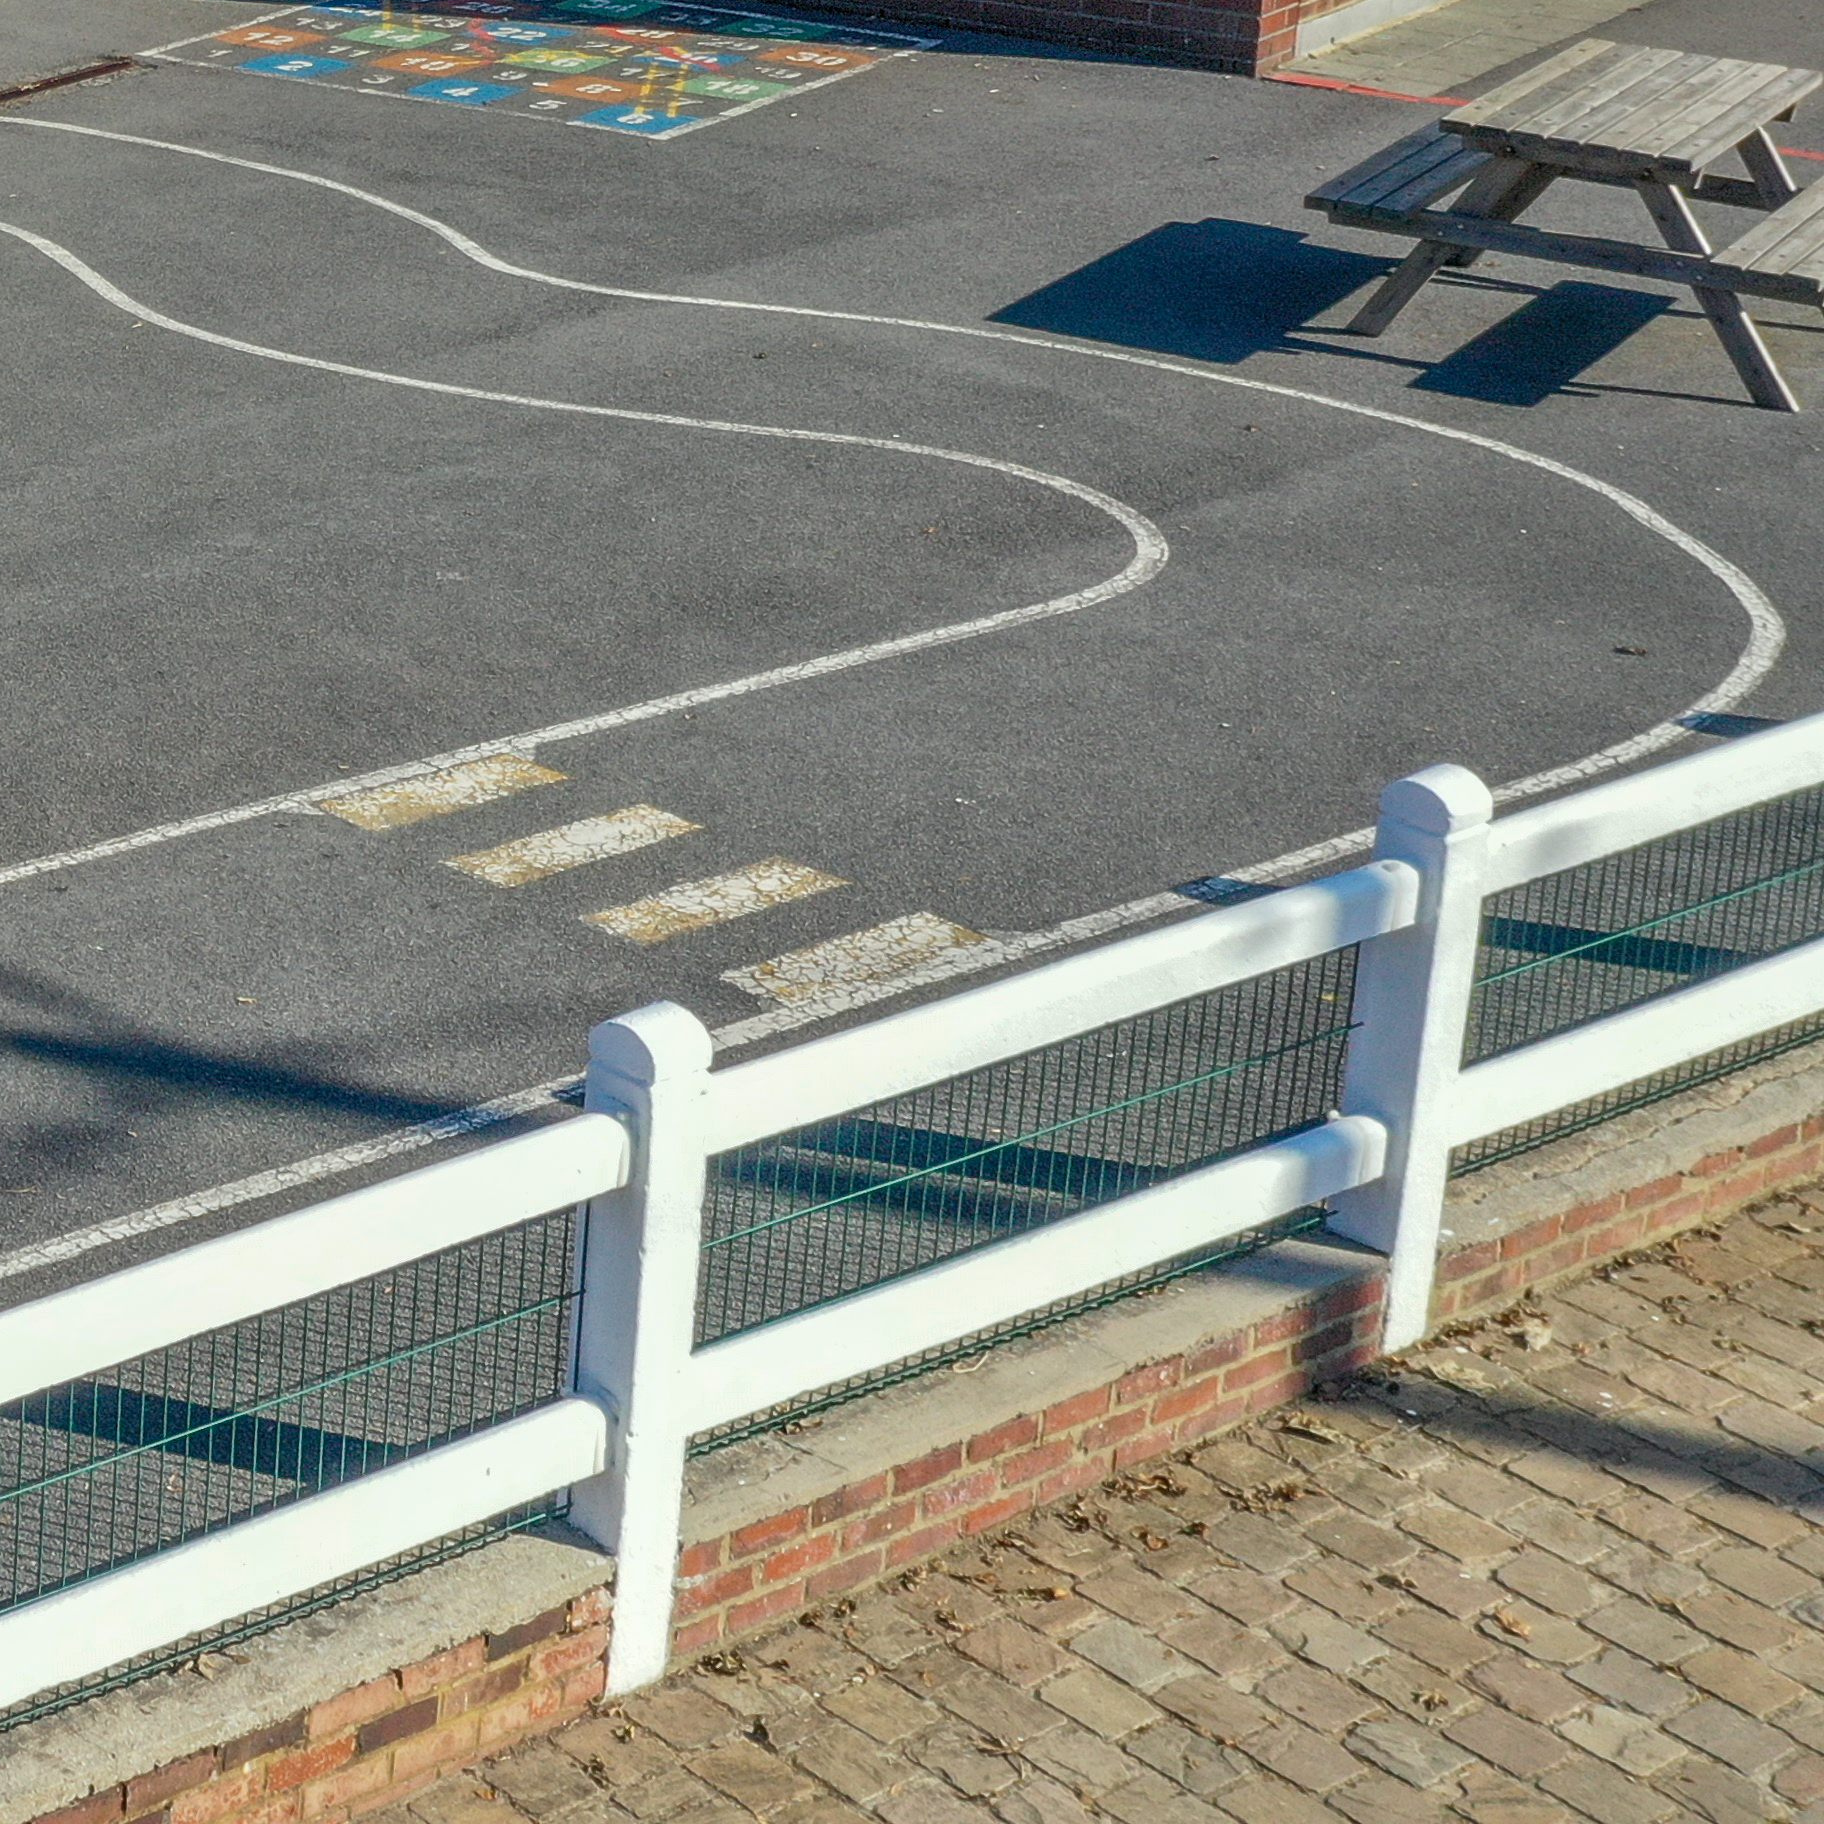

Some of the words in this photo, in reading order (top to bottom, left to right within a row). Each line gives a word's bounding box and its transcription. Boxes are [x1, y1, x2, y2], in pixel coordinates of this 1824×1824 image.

[296, 17, 343, 30] 13
[243, 31, 295, 45] 12
[368, 29, 424, 43] 14
[487, 27, 547, 40] 22
[207, 49, 233, 58] 1
[326, 45, 374, 58] 11
[400, 57, 455, 71] 10
[786, 51, 846, 66] 30
[273, 60, 313, 72] 2
[361, 74, 395, 85] 3
[492, 70, 528, 81] 9
[442, 87, 479, 97] 4
[575, 83, 622, 94] 8
[706, 81, 760, 95] 18
[529, 99, 568, 110] 5
[616, 114, 655, 125] 6
